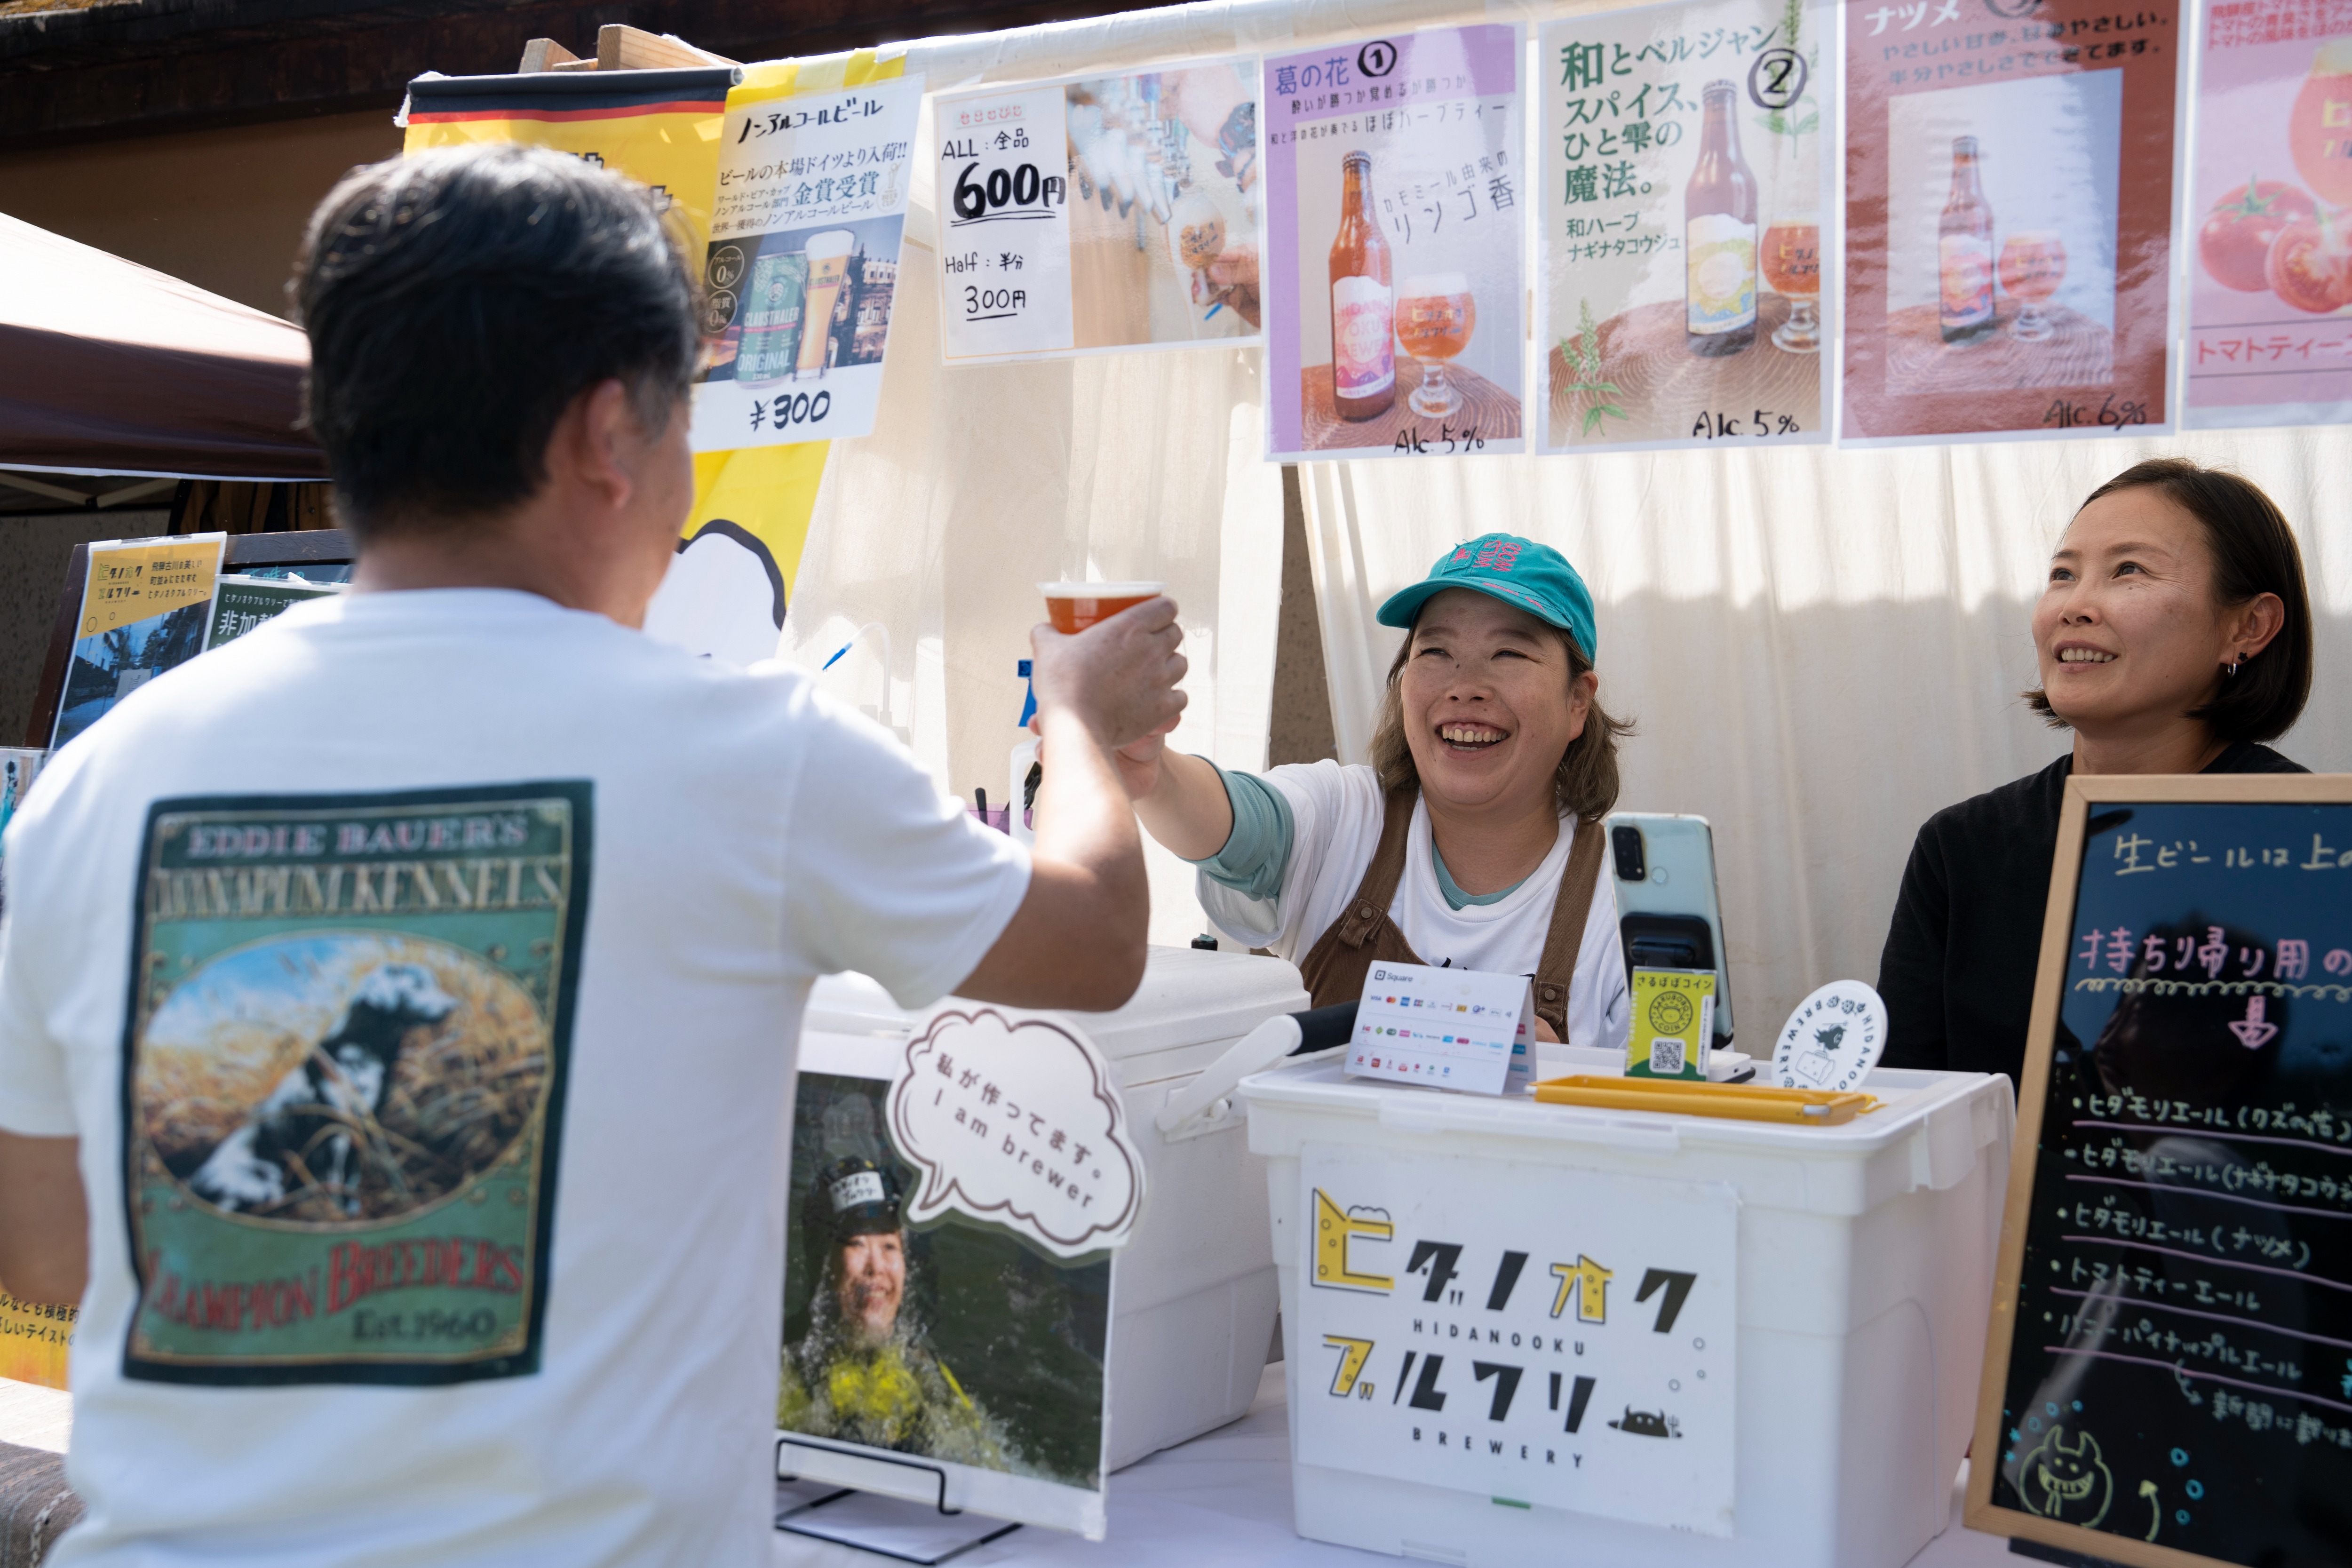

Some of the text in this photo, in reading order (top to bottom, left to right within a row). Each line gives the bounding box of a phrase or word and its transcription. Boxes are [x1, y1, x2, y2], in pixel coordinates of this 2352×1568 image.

[1275, 56, 1350, 96] 葛の花
[1560, 25, 1779, 92] 和とベルジャン
[1291, 75, 1466, 114] 酔いが勝つか覚めるが勝つか
[738, 97, 883, 144] ノンアルコールビール
[941, 138, 979, 160] ALL
[994, 128, 1029, 150] 全品
[1563, 120, 1683, 161] ひと雫の
[793, 171, 880, 207] 金賞受賞
[953, 162, 1066, 219] 600円
[1563, 159, 1652, 206] 魔法。
[1566, 211, 1640, 238] 和ハーブ
[945, 251, 978, 274] Half
[1567, 232, 1681, 263] ナギナタコウジュ
[744, 306, 800, 327] CLAUSTHALER
[965, 285, 1026, 314] 300円
[737, 349, 791, 372] ORIGINAL
[750, 390, 831, 432] ¥300
[219, 610, 274, 636] 非加
[186, 824, 328, 859] EDDIE
[2078, 926, 2352, 979] 持ち帰り用の
[1386, 972, 1414, 984] Square
[1637, 975, 1712, 990] さるぼぼコイン
[937, 1052, 1102, 1181] 私が作ってます。
[954, 1106, 989, 1138] am
[1001, 1133, 1094, 1208] brewer
[1413, 1319, 1586, 1358] HIDANOOKU
[1413, 1426, 1583, 1470] BREWERY
